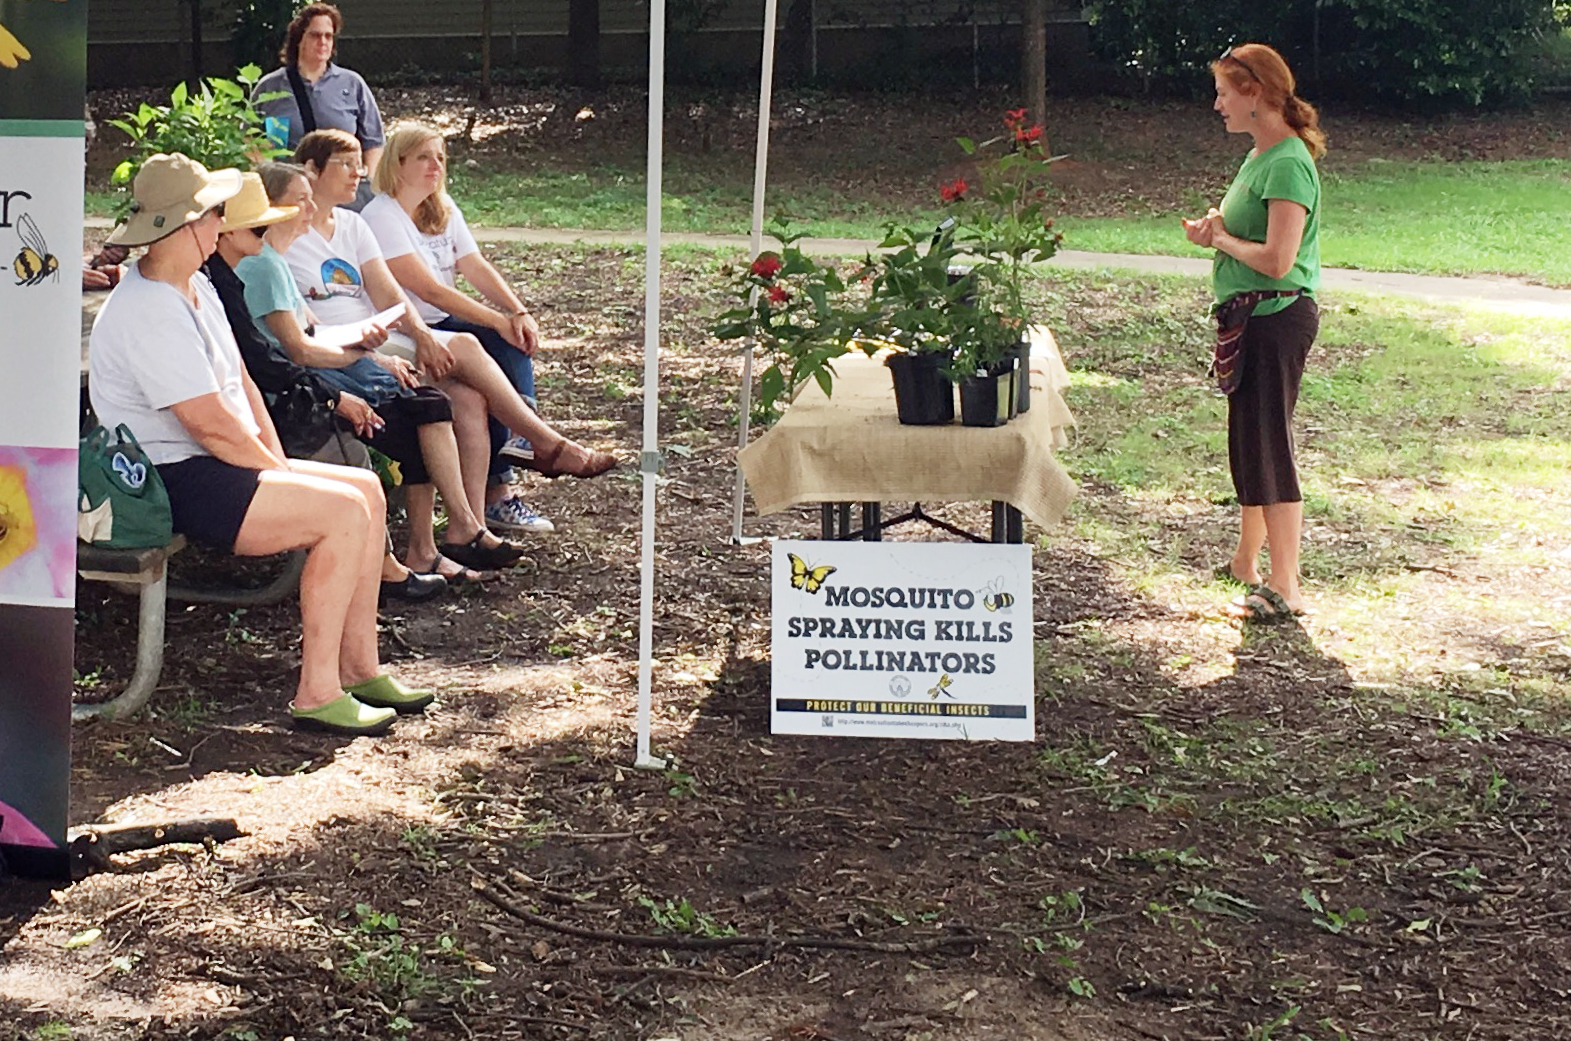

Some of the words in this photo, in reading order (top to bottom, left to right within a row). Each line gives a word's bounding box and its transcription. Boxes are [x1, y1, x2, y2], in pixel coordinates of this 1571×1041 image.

[824, 585, 975, 610] MOSQUITO
[787, 616, 926, 641] SPRAYING
[934, 620, 1014, 644] KILLS
[804, 648, 996, 675] POLLINATORS
[806, 700, 852, 712] PROTECT
[855, 701, 877, 713] OUR
[880, 702, 942, 715] BENEFICIAL
[946, 705, 990, 716] INSECTS
